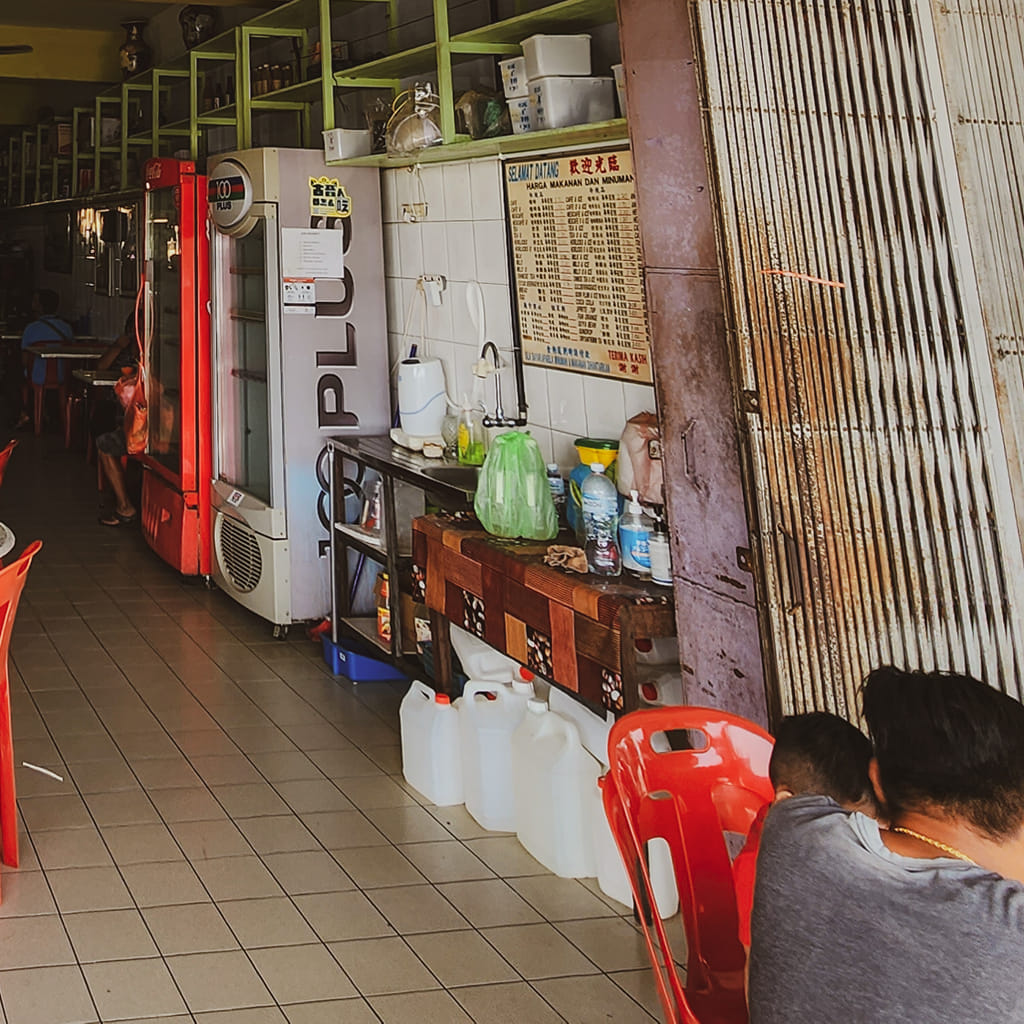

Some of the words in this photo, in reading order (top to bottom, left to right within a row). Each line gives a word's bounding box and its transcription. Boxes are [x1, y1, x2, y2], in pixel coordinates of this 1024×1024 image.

[508, 163, 534, 182] SELAMAT
[535, 161, 560, 179] DATANG
[216, 179, 232, 199] 100
[526, 181, 547, 190] HARGA
[549, 179, 583, 189] MAKANAN
[584, 177, 600, 186] DAN
[216, 201, 232, 212] PLUS
